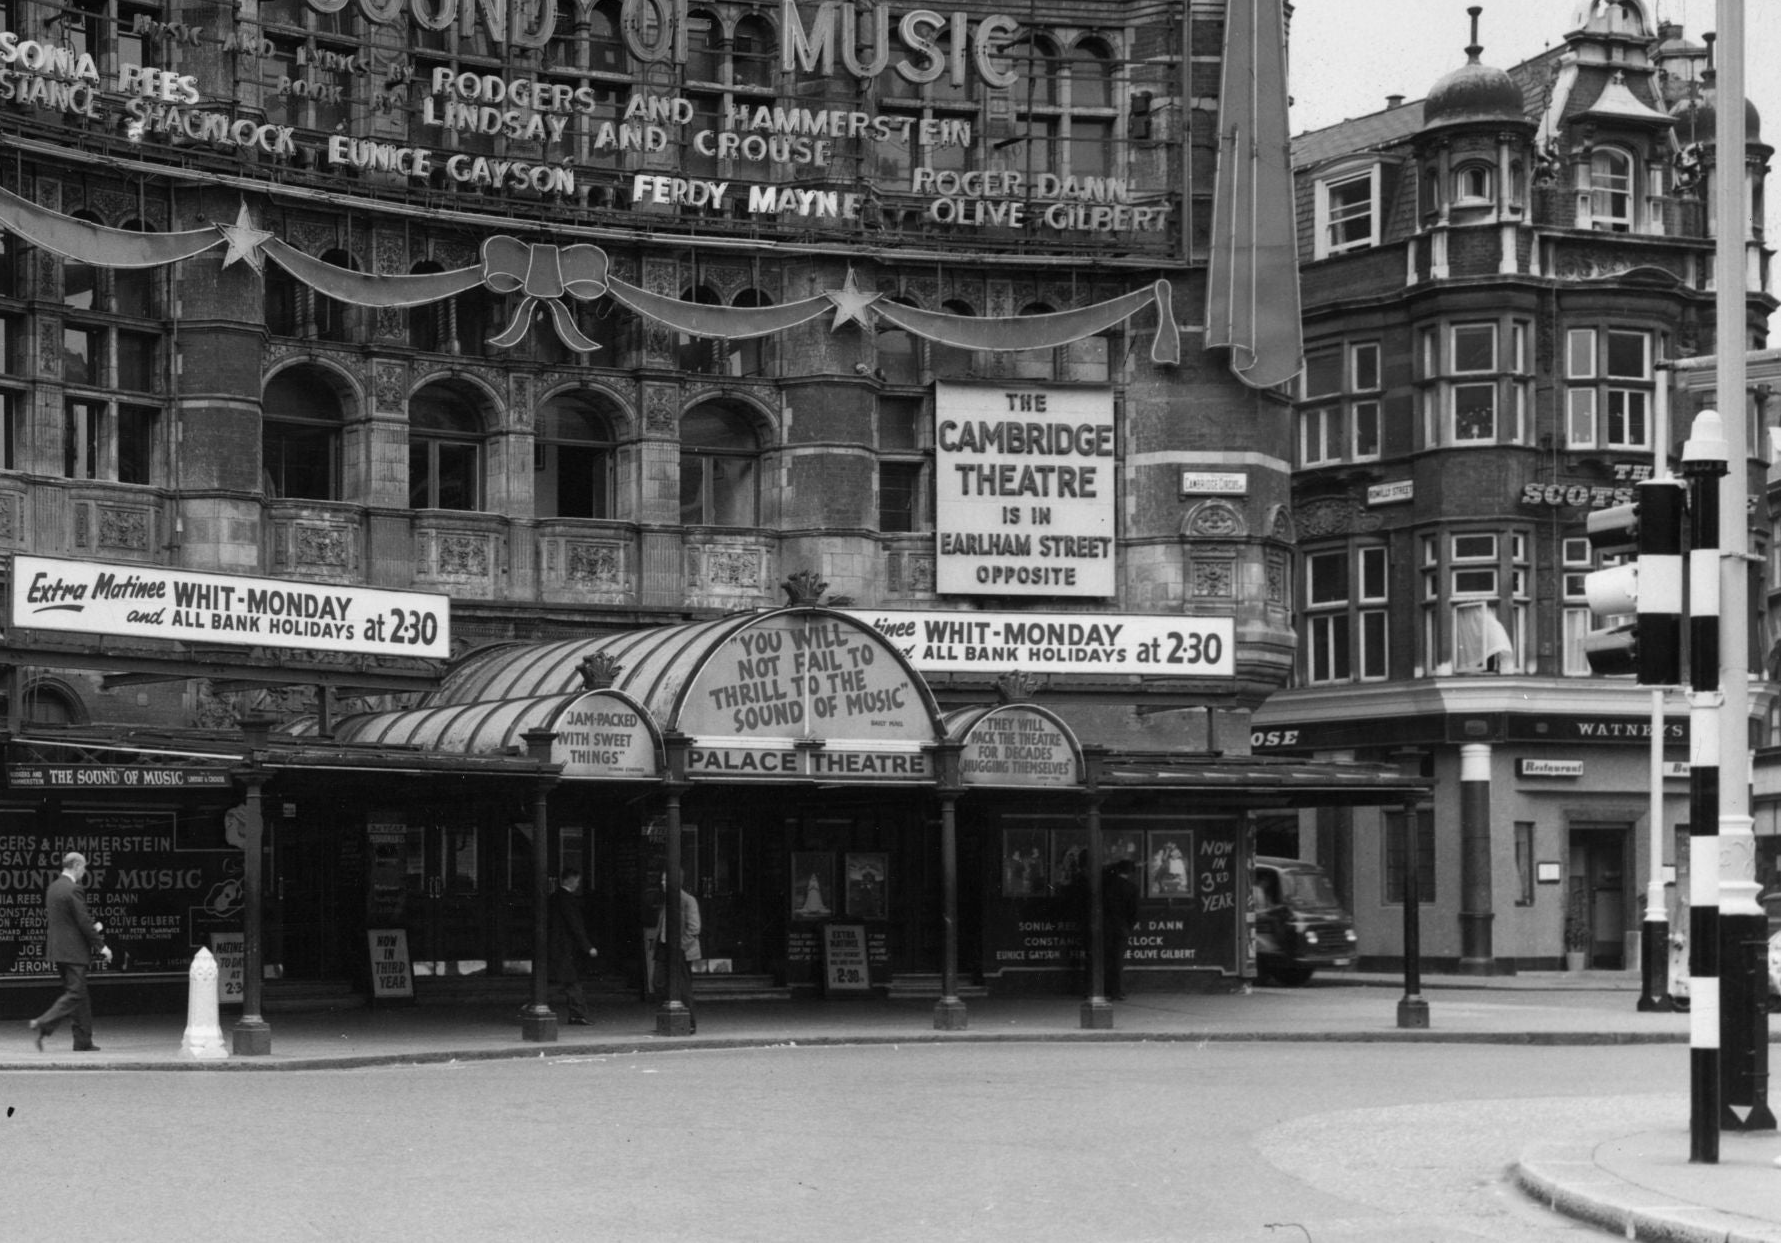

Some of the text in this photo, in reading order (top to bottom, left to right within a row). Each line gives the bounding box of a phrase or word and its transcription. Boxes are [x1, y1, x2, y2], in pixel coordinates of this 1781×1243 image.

[781, 0, 1018, 89] MUSIC
[121, 62, 200, 104] REES
[432, 66, 971, 147] RODGERS AND HAMMERSTEIN
[423, 96, 569, 142] LINDSAY
[594, 121, 667, 152] AND
[693, 129, 831, 167] CROUSE
[125, 98, 297, 156] SHACKLOCK
[329, 135, 433, 178] EUNICE
[446, 155, 575, 196] GAYSON
[633, 174, 729, 209] FERDY
[748, 185, 864, 219] MAYNE
[913, 167, 1128, 202] ROGER DANN
[930, 198, 1171, 232] OLIVE GILBERT
[1005, 393, 1047, 413] THE
[938, 420, 1114, 457] CAMBRIDGE
[955, 463, 1097, 499] THEATRE
[1614, 464, 1652, 480] TH
[1002, 506, 1052, 525] IS IN
[940, 532, 1113, 560] EARLHAM STREET
[976, 565, 1077, 586] OPPOSITE
[27, 572, 86, 603] Extra
[91, 572, 166, 600] Matinee
[173, 580, 353, 621] WHIT-MONDAY
[363, 615, 386, 642] at
[126, 607, 355, 641] and ALL BANK HOLIDAYS
[790, 623, 849, 651] WILL
[924, 619, 1124, 646] WHIT-MONDAY
[1136, 639, 1162, 663] at
[737, 659, 781, 682] NOT
[794, 647, 843, 676] FAIL
[848, 644, 874, 668] TO
[922, 644, 958, 660] ALL
[965, 645, 1019, 661] BANK
[1028, 647, 1127, 663] HOLIDAYS
[709, 669, 868, 710] THRILL TO THE
[733, 700, 804, 734] SOUND
[813, 695, 838, 719] OF
[1018, 718, 1045, 732] WILL
[559, 731, 632, 748] WITH SWEET
[971, 731, 1061, 747] PACK THE THEATRE
[687, 750, 925, 774] PALACE THEATRE
[979, 746, 1053, 760] FOR DECADES
[49, 769, 183, 785] THE SOUND OF MUSIC
[962, 759, 1009, 774] HUGGING
[1524, 760, 1583, 774] Restaurant
[40, 837, 51, 851] &
[54, 835, 171, 853] HAMMERSTEIN
[1199, 839, 1235, 856] NOW
[37, 852, 48, 866] &
[1212, 856, 1227, 869] IN
[82, 868, 107, 889] OF
[116, 868, 203, 889] MUSIC
[1201, 892, 1235, 913] YEAR
[377, 936, 397, 947] NOW
[384, 948, 394, 960] IN
[375, 961, 405, 974] THIRD
[379, 975, 406, 989] YEAR
